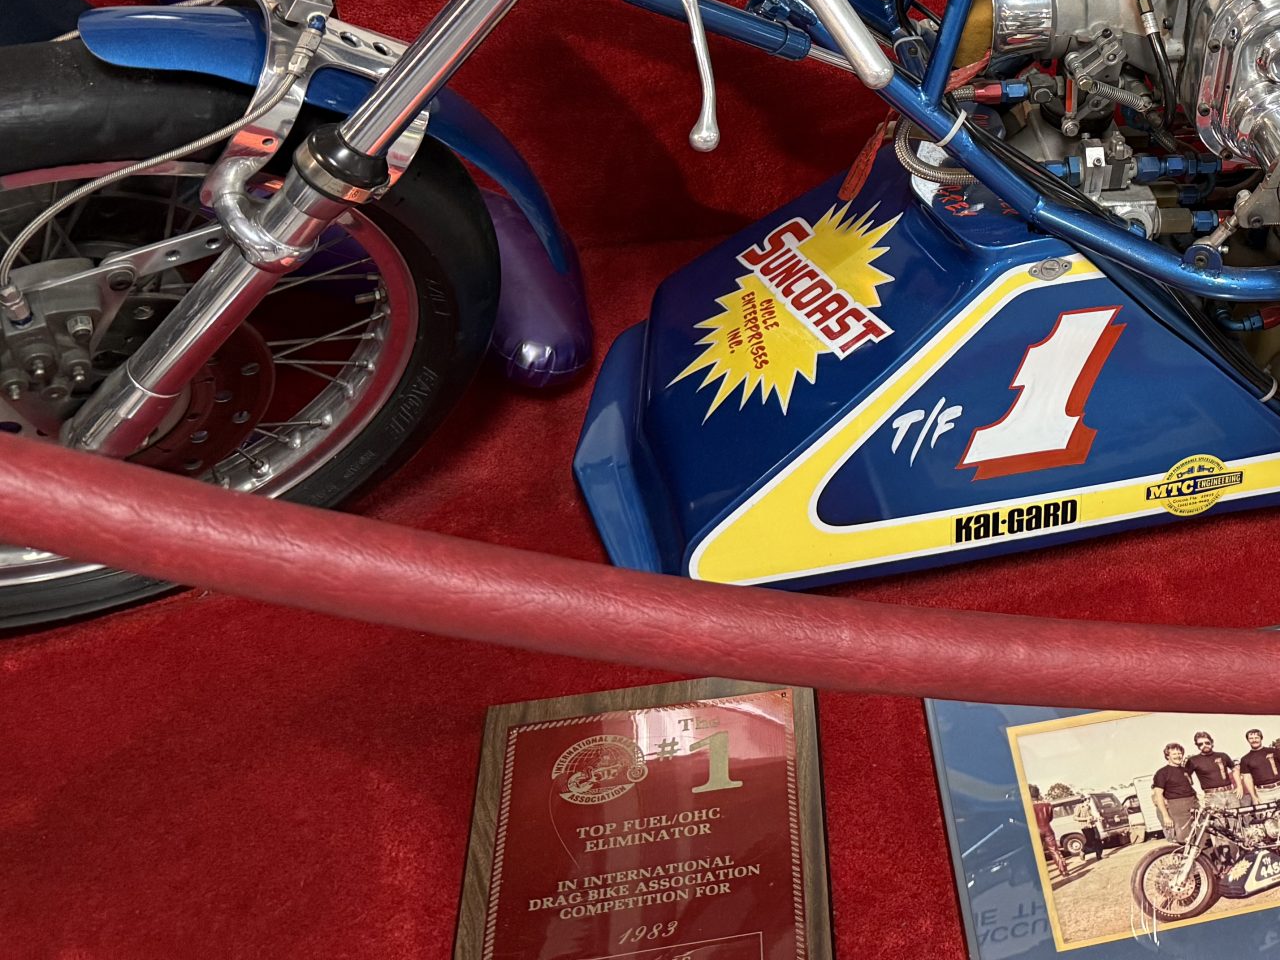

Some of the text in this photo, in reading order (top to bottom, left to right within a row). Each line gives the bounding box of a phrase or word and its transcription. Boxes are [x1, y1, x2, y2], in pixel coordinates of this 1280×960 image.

[740, 220, 887, 354] SUNCOAST
[742, 291, 769, 370] ENTERPRISES
[760, 298, 780, 330] CYCLE
[727, 328, 744, 354] INC.
[958, 305, 1127, 481] 1
[891, 396, 962, 467] T/F
[1150, 480, 1194, 500] MTC
[1196, 474, 1241, 489] ENGINEERING
[678, 716, 720, 732] The
[554, 736, 609, 774] INTERNATIONAL
[568, 786, 626, 803] ASSOCIATION
[576, 807, 721, 839] TOP FUEL/OHC
[584, 822, 712, 853] ELIMINATOR
[528, 864, 761, 912] DRAG BIKE ASSOCIATION
[558, 856, 734, 892] IN INTERNATIONAL
[559, 882, 731, 920] COMPETITION FOR
[618, 920, 678, 944] 1983
